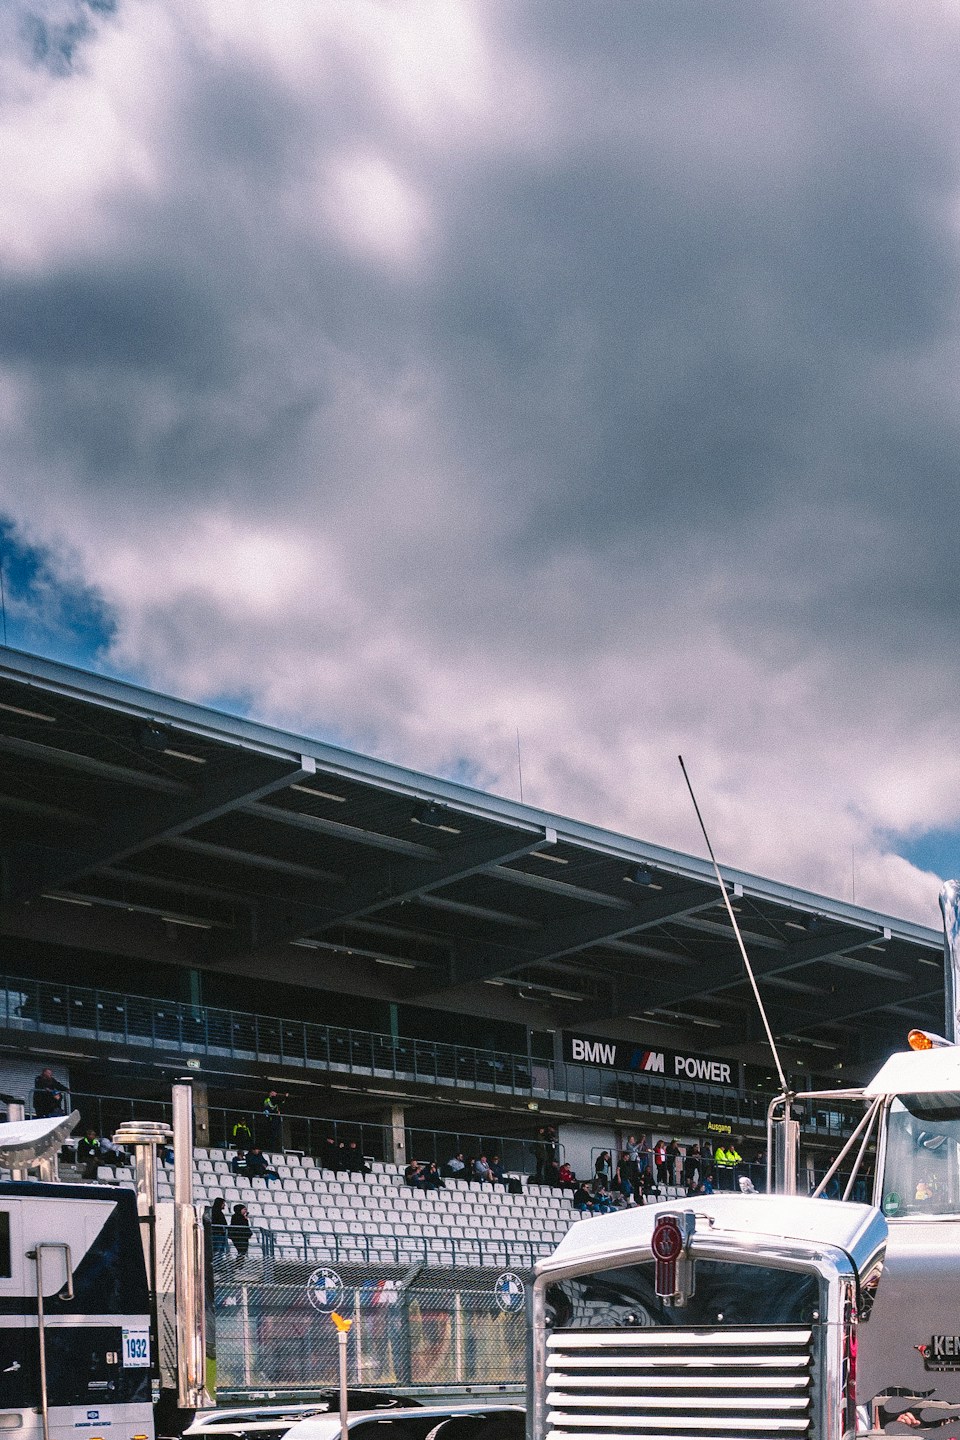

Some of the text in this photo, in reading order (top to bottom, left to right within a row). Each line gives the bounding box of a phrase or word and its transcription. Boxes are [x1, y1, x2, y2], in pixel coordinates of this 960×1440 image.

[572, 1038, 616, 1065] BMW
[674, 1056, 732, 1083] POWER
[707, 1121, 732, 1134] Ausgang
[126, 1338, 147, 1358] 1932
